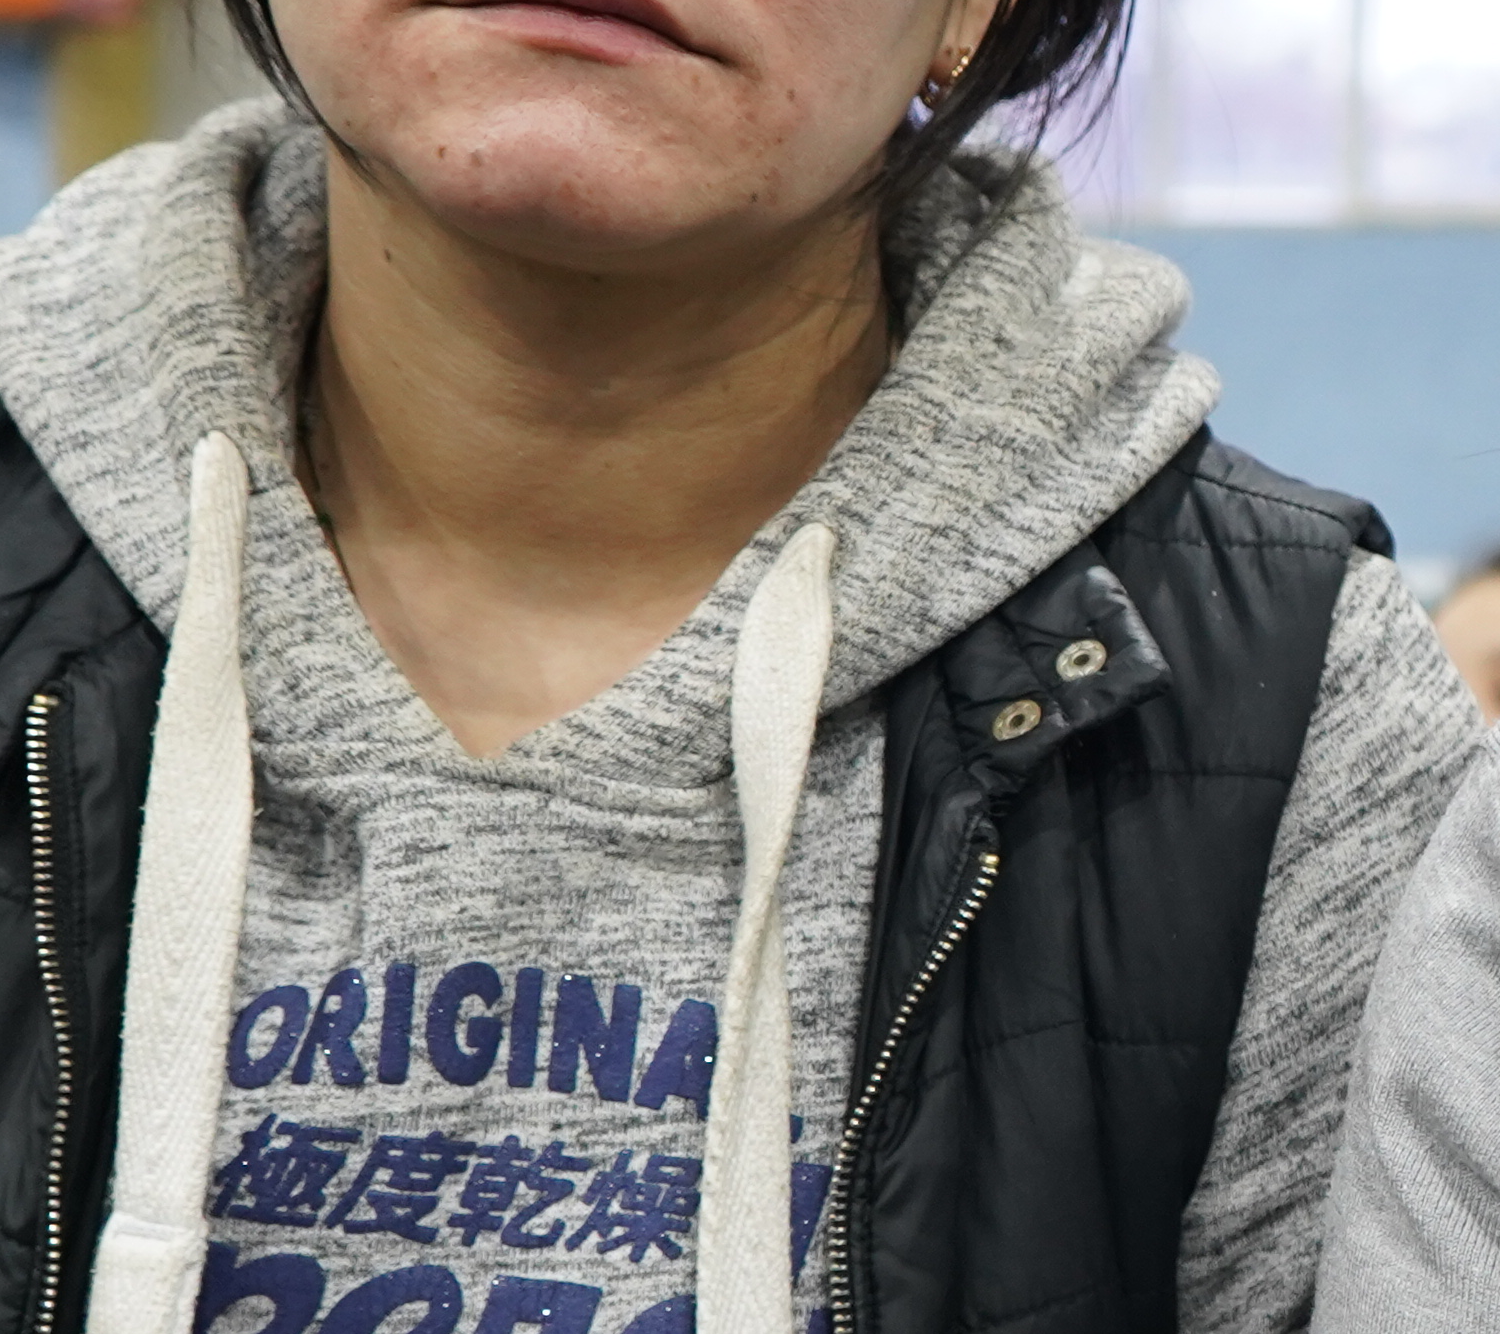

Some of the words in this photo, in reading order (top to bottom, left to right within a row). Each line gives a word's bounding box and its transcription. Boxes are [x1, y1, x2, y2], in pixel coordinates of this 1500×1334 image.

[227, 961, 803, 1142] ORIGINA
[211, 1113, 702, 1263] 極度乾燥
